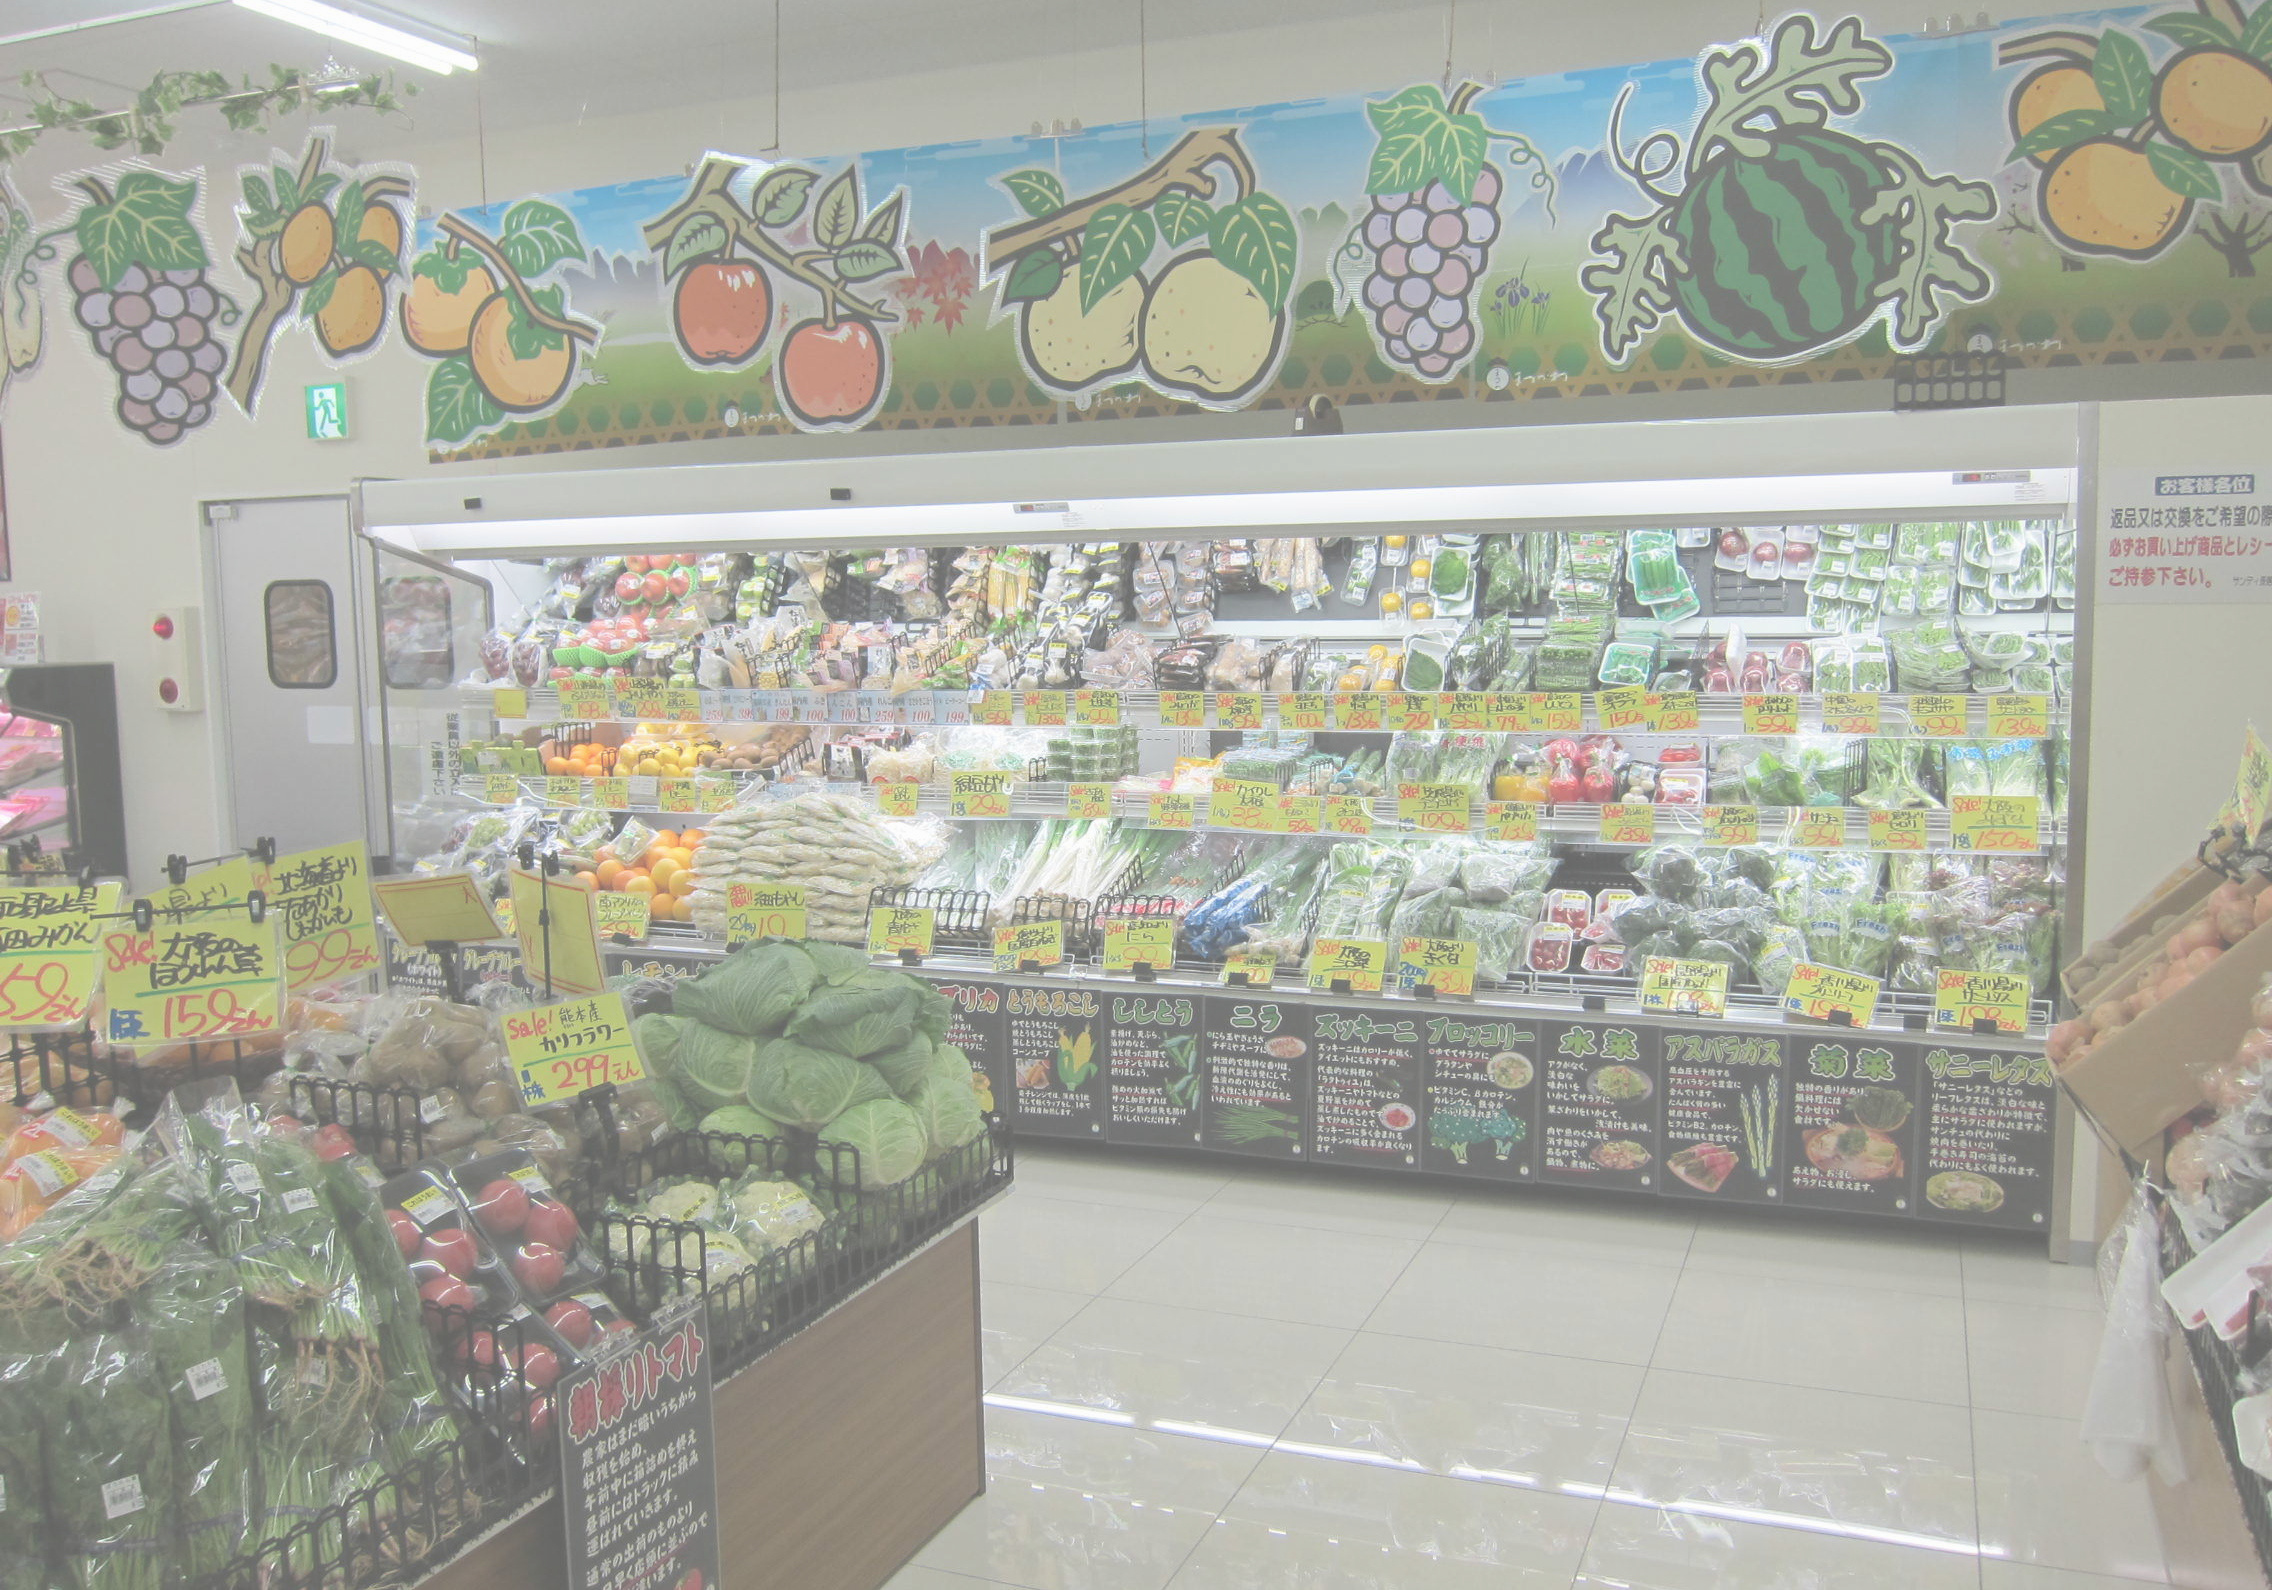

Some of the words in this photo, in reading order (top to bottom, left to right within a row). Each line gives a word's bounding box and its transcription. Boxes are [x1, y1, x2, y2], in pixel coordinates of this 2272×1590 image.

[2160, 476, 2251, 494] お客様各位
[2110, 505, 2272, 529] 返品又は交換をご希望の際
[2108, 566, 2212, 588] ご持参下さい。
[1953, 798, 1983, 814] Sale!
[104, 931, 156, 974] Sale!
[558, 999, 604, 1030] 熊本産
[931, 984, 999, 1013] プリカ
[1006, 988, 1099, 1018] とうもろこし
[1112, 998, 1194, 1026] ししとう
[506, 1008, 553, 1041] Sale!
[1230, 1004, 1283, 1033] ニラ
[1314, 1013, 1419, 1043] ズッキーニ
[1426, 1017, 1535, 1050] ブロッコリー
[539, 1023, 625, 1055] カリフラワー
[1558, 1026, 1639, 1061] 水菜
[1663, 1035, 1782, 1067] アスパラガス
[1808, 1043, 1896, 1082] 菊菜
[1926, 1048, 2053, 1087] サニーレタス
[1317, 1087, 1400, 1099] ズッキーニやトマトなどの
[1930, 1126, 2011, 1140] サンチュの代わりに
[582, 1385, 697, 1470] 農家はまだ暗いうちから
[584, 1428, 698, 1512] 午前中に箱詰めを終え
[585, 1449, 699, 1537] 昼前にはトラックに積み
[586, 1487, 679, 1558] 運ばれていきます。
[586, 1500, 694, 1588] 通常の出荷のものより
